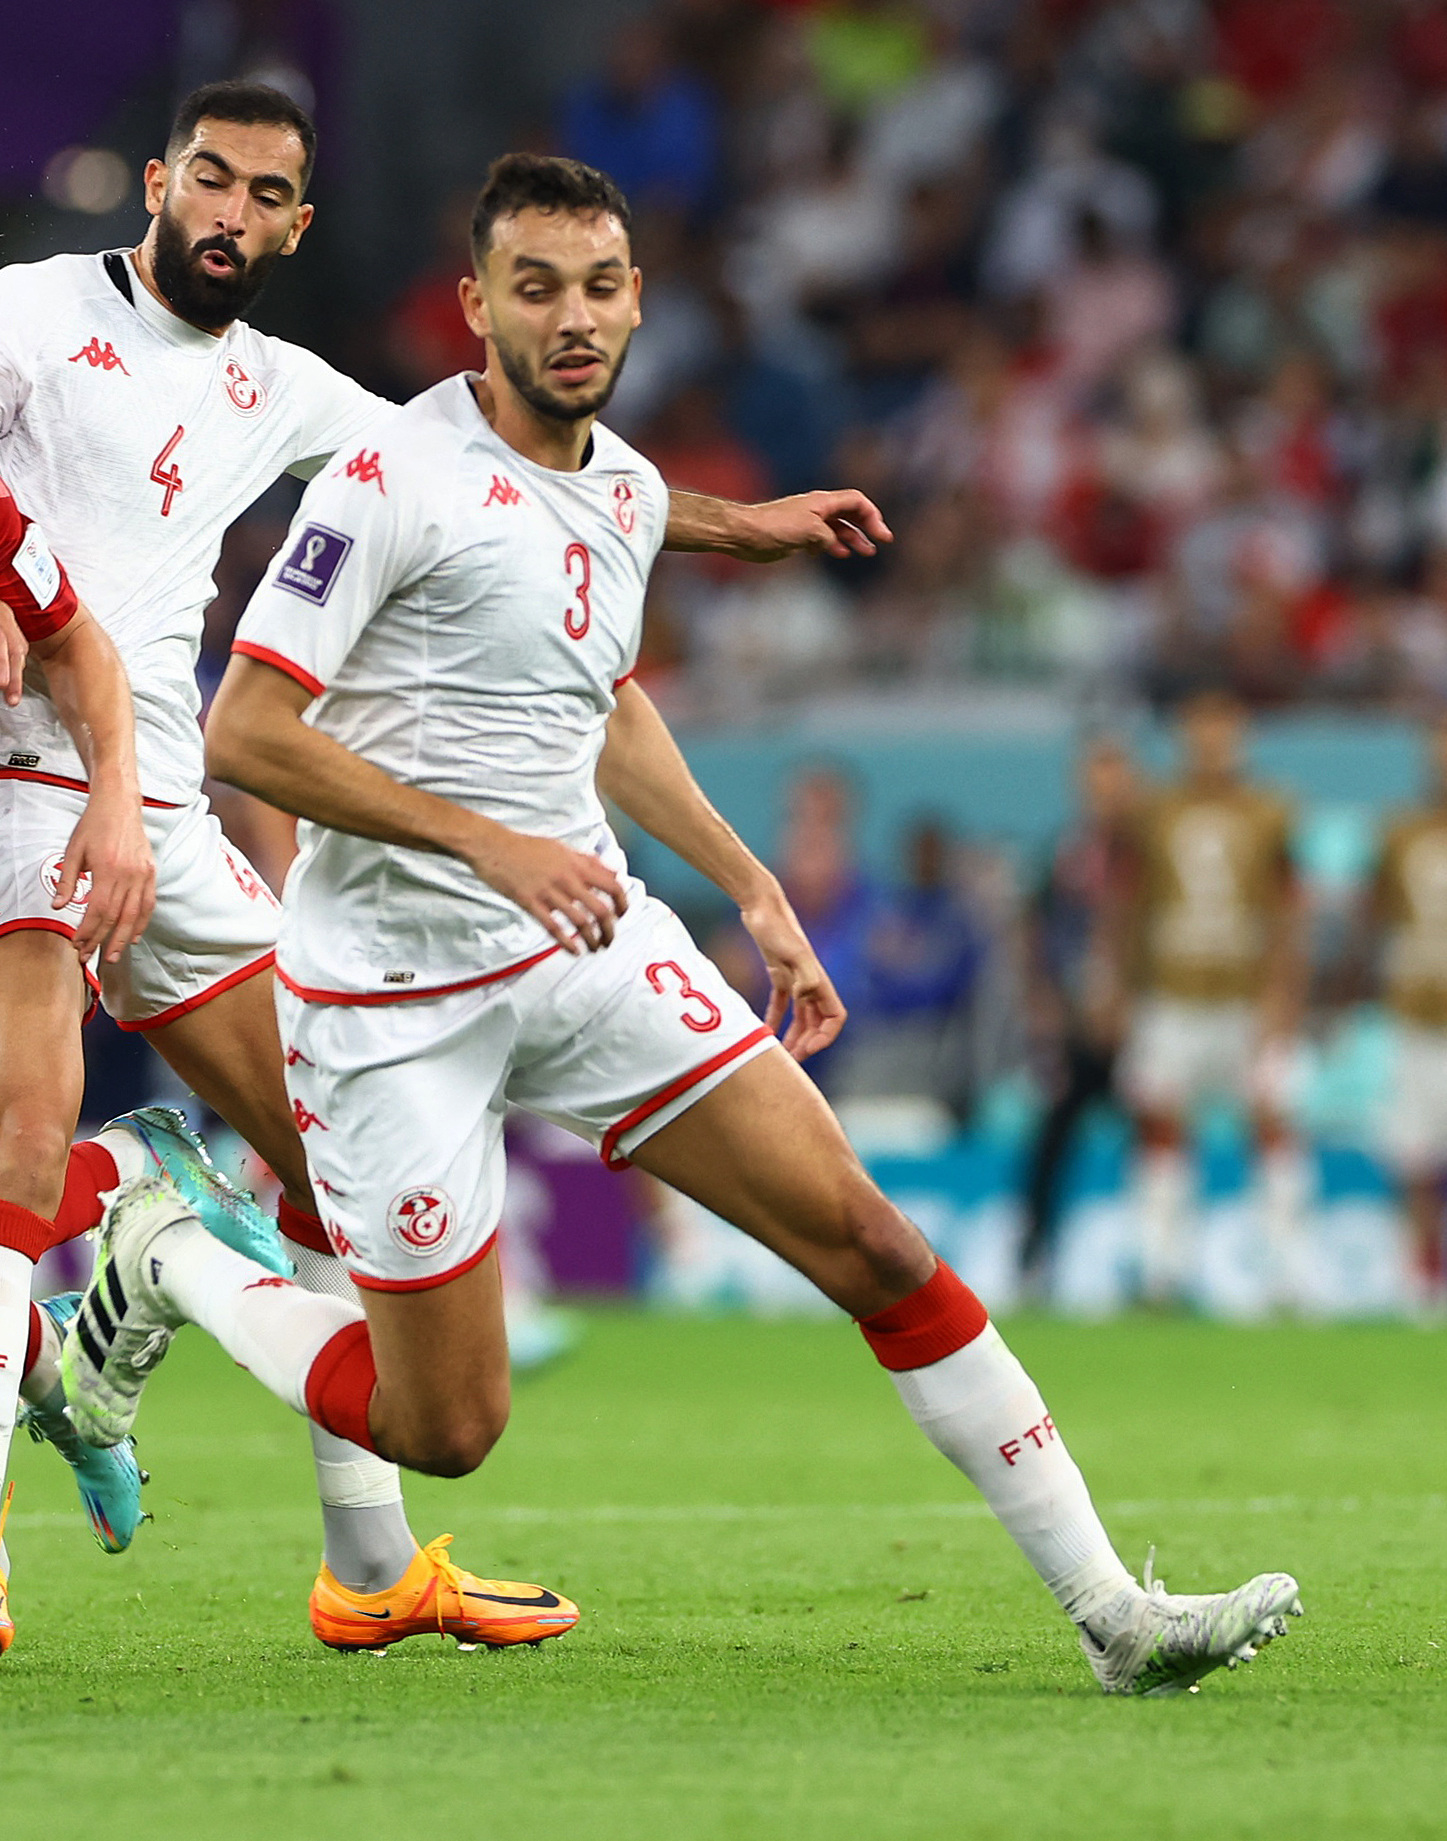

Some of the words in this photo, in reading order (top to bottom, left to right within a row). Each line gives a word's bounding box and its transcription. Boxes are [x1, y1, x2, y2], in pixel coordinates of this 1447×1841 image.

[150, 424, 184, 517] 4
[564, 543, 590, 640] 3
[645, 960, 721, 1032] 3
[998, 1413, 1055, 1466] FTF
